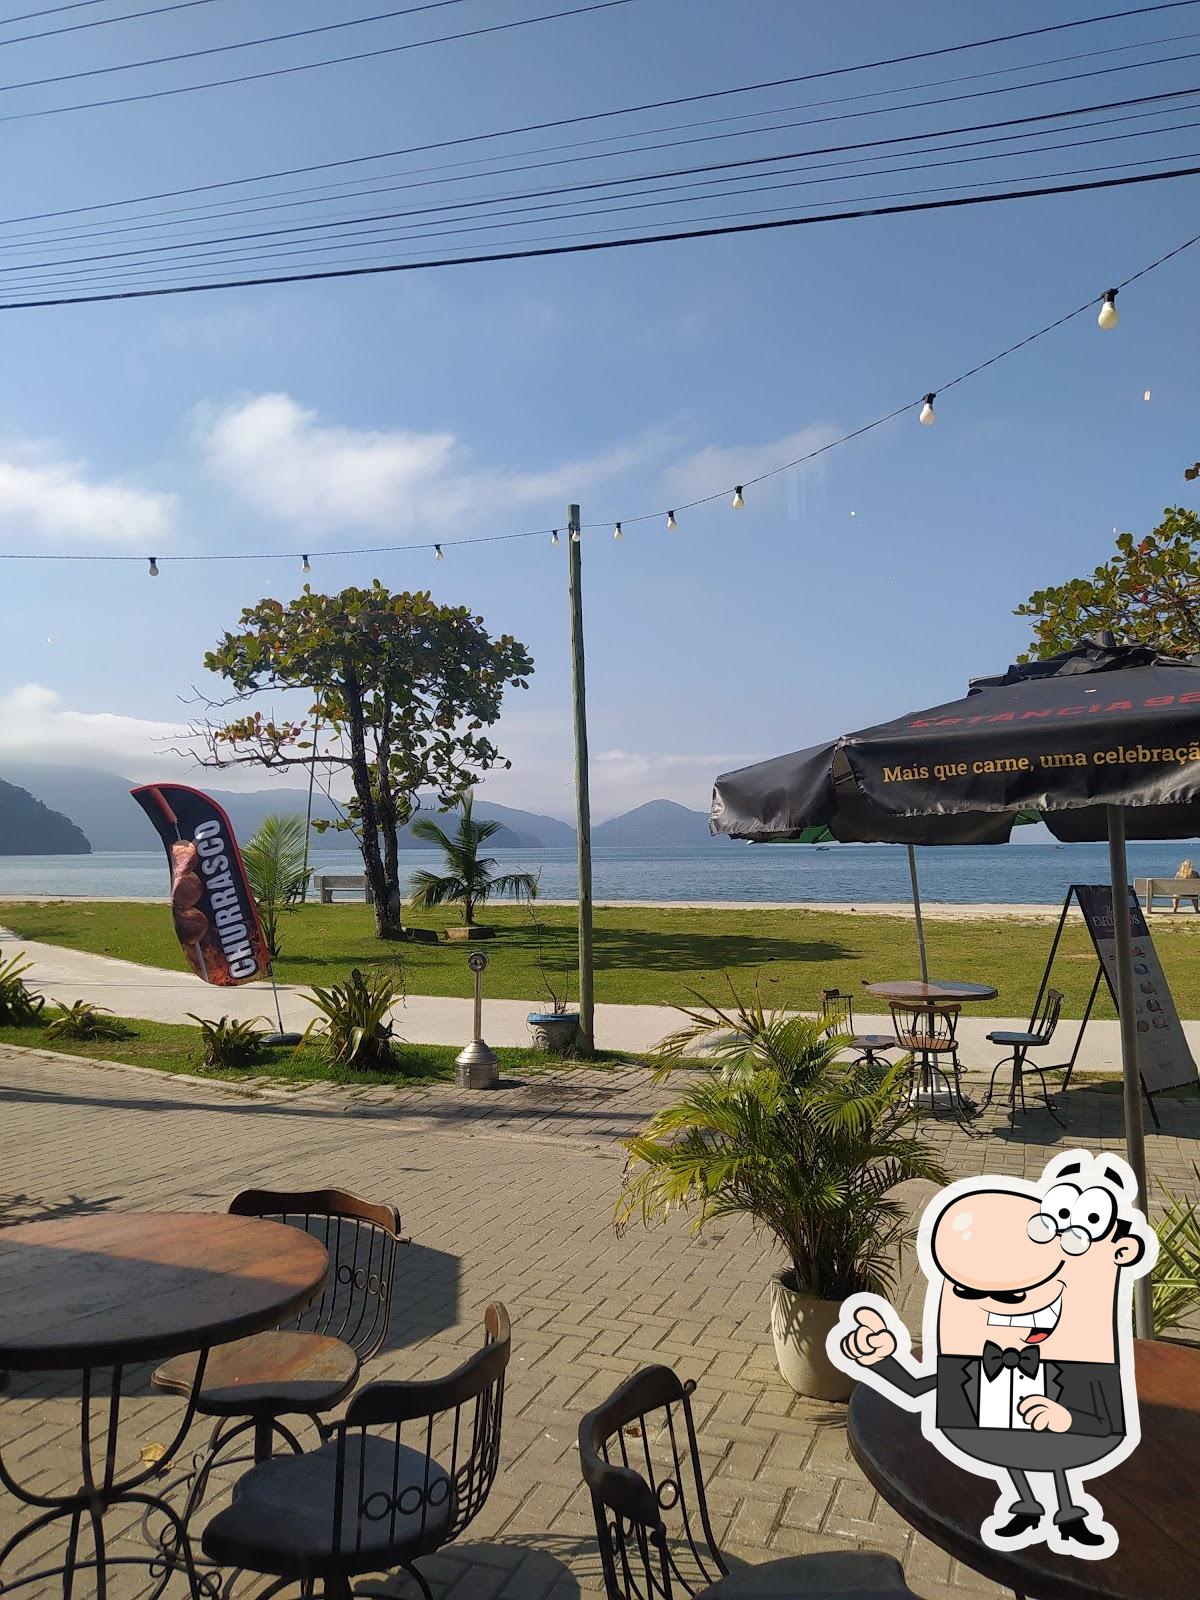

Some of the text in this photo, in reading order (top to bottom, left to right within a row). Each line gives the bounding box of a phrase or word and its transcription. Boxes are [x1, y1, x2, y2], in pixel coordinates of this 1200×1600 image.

[882, 763, 930, 783] Mais
[932, 762, 968, 781] que
[972, 756, 1034, 775] carne,
[1039, 751, 1088, 769] uma
[194, 819, 258, 979] CHURRASCO
